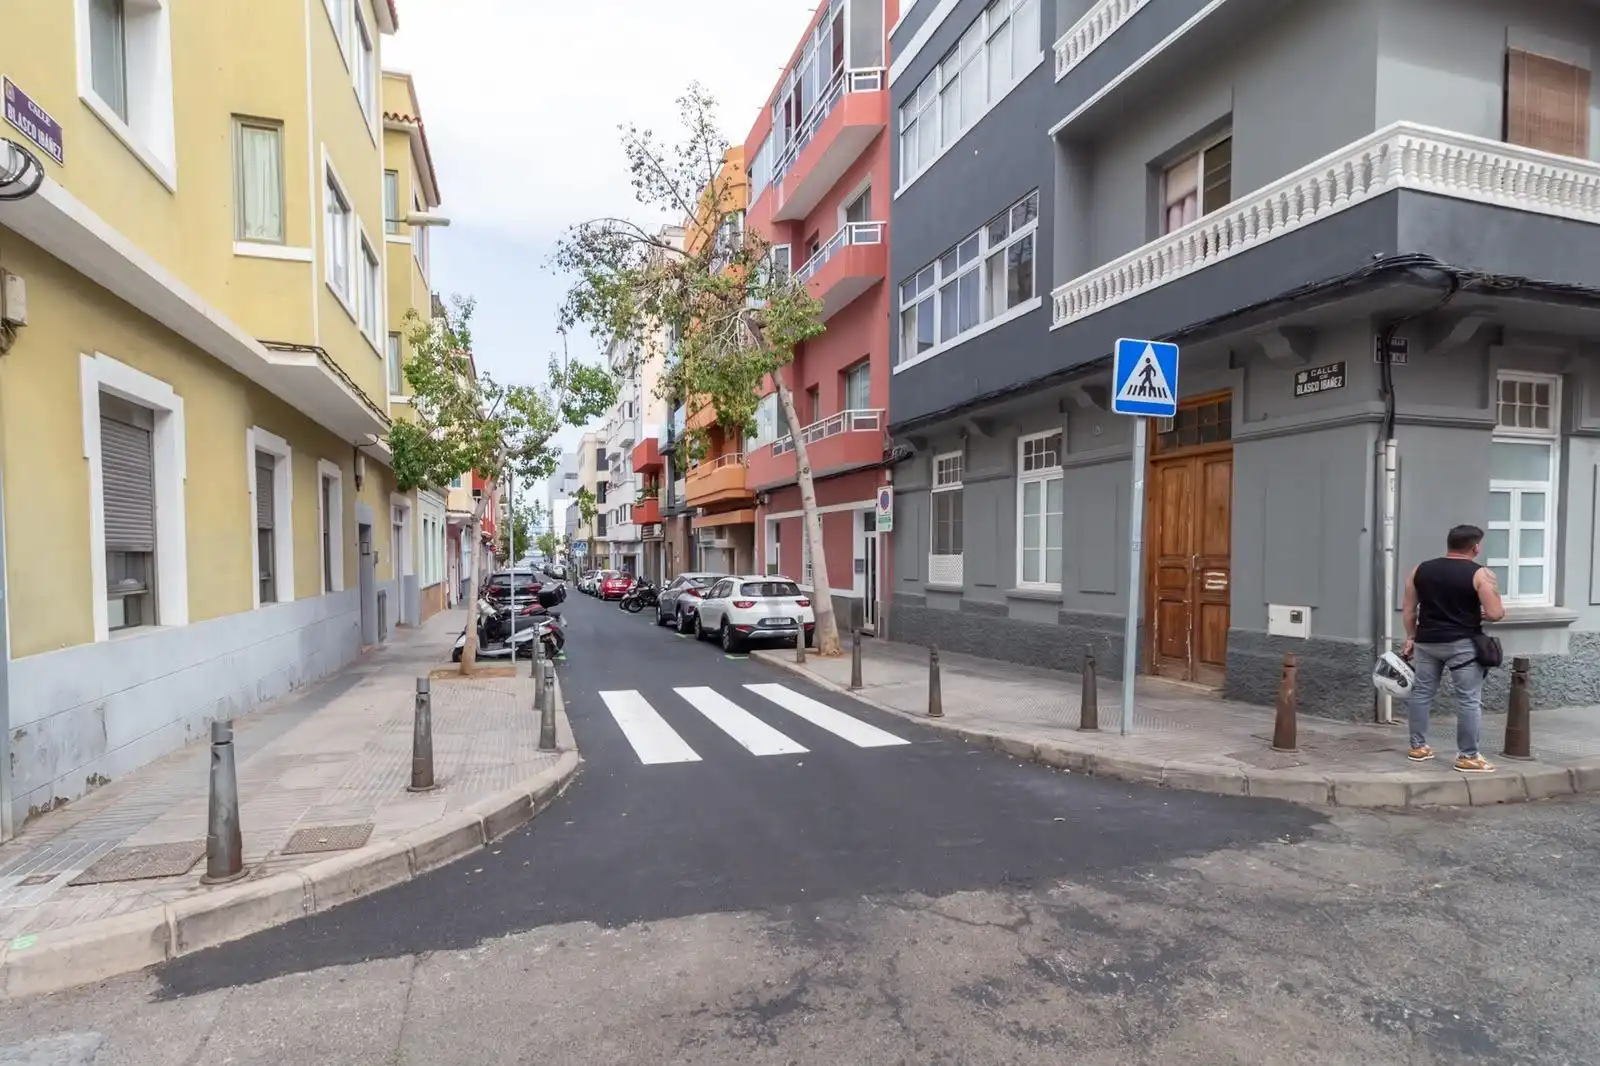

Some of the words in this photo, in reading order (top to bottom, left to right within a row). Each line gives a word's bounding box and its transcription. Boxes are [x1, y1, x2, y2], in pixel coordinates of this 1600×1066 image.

[7, 103, 37, 140] BLASCO
[28, 101, 51, 127] CALLE
[1310, 364, 1338, 376] CALLE
[1296, 381, 1320, 395] BLASCO
